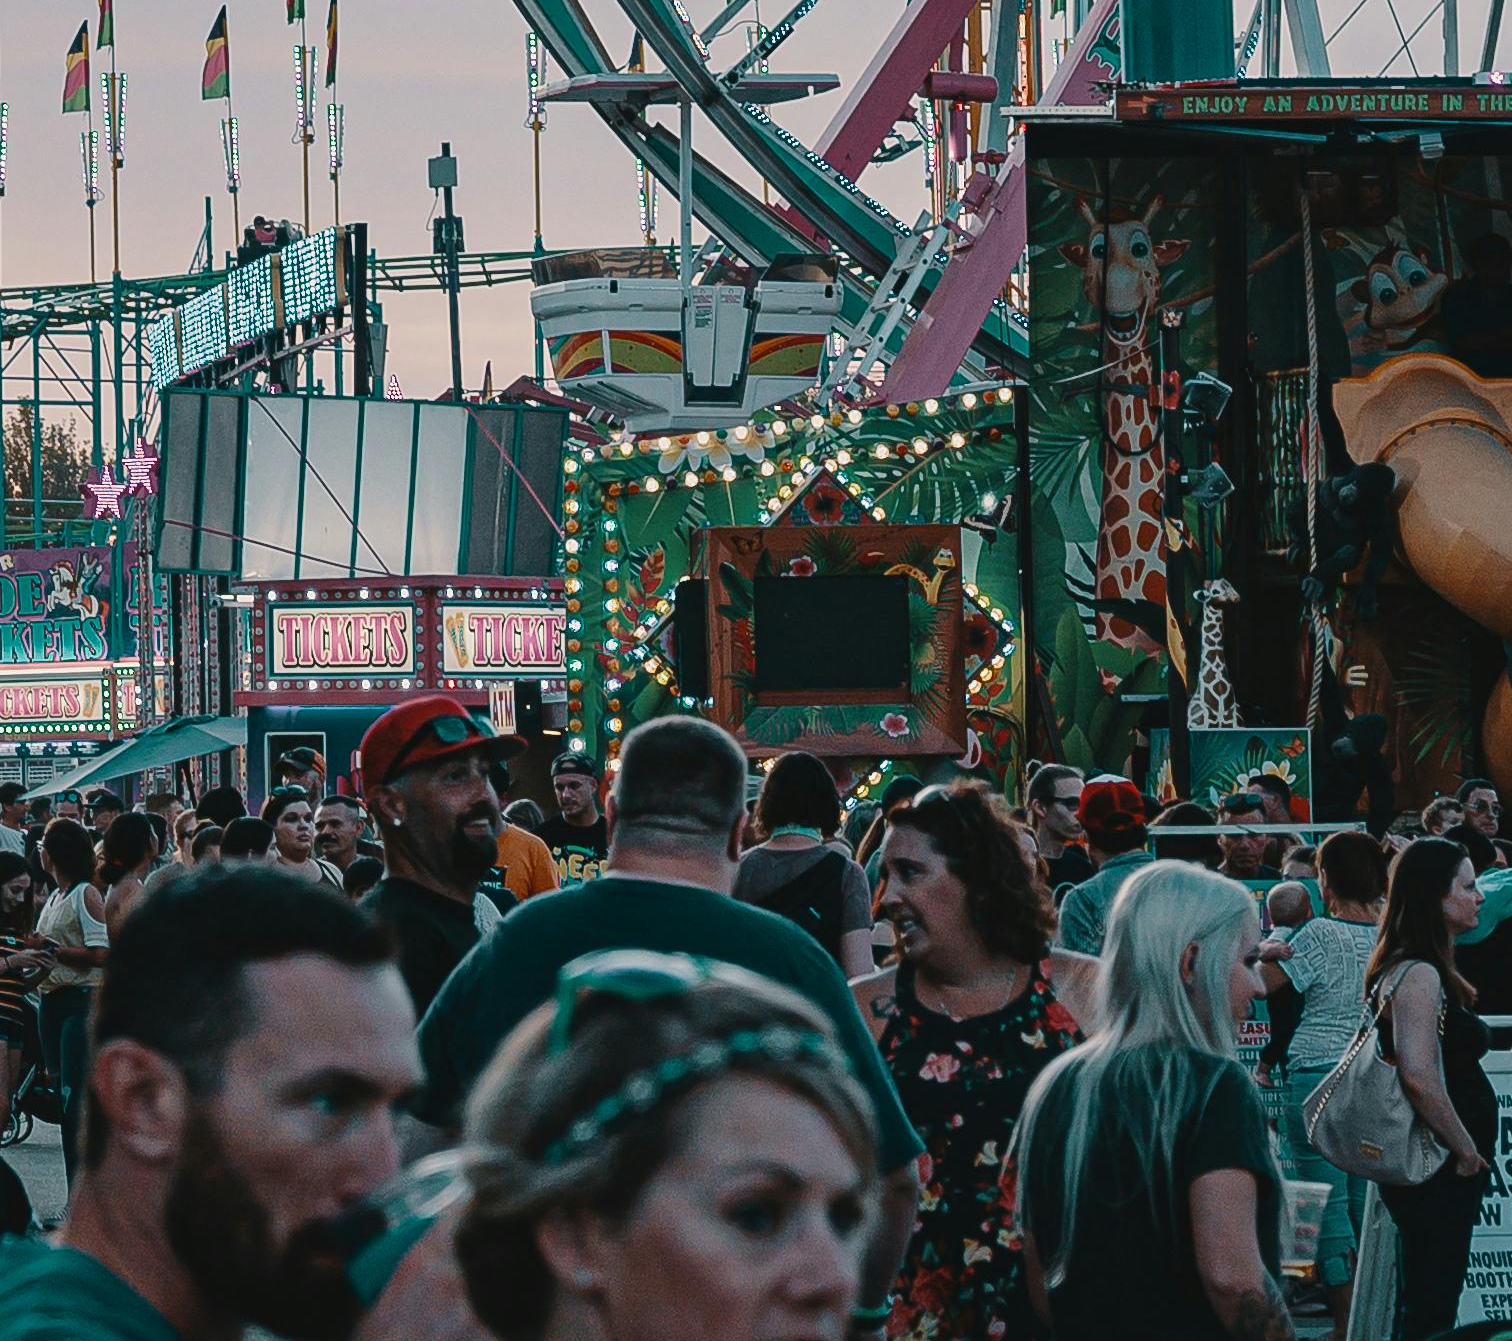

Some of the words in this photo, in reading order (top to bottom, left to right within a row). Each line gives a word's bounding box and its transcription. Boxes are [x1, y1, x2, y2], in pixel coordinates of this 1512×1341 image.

[1183, 95, 1247, 114] ENJOY
[1263, 95, 1292, 112] AN
[1306, 94, 1429, 112] ADVENTURE
[1442, 94, 1463, 112] IN
[279, 612, 408, 667] TICKETS
[493, 690, 514, 728] ATM
